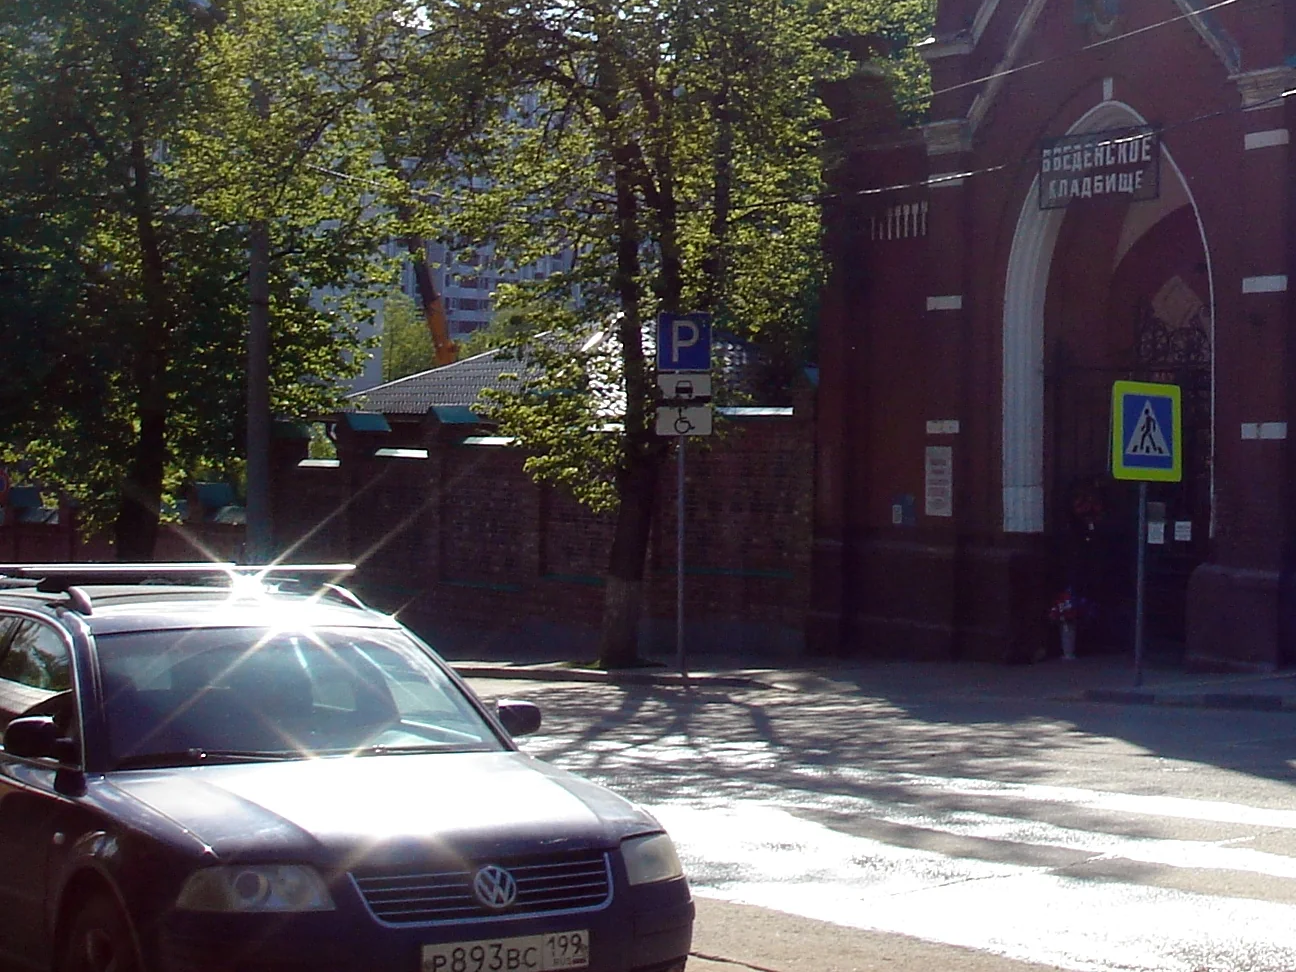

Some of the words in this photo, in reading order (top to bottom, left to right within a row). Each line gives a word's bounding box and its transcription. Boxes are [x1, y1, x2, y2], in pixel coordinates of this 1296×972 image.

[1042, 136, 1152, 173] ВВЕДЕНСКОЕ
[1049, 170, 1144, 199] КЛАДБИЩЕ
[671, 319, 700, 363] P
[546, 933, 582, 957] 199
